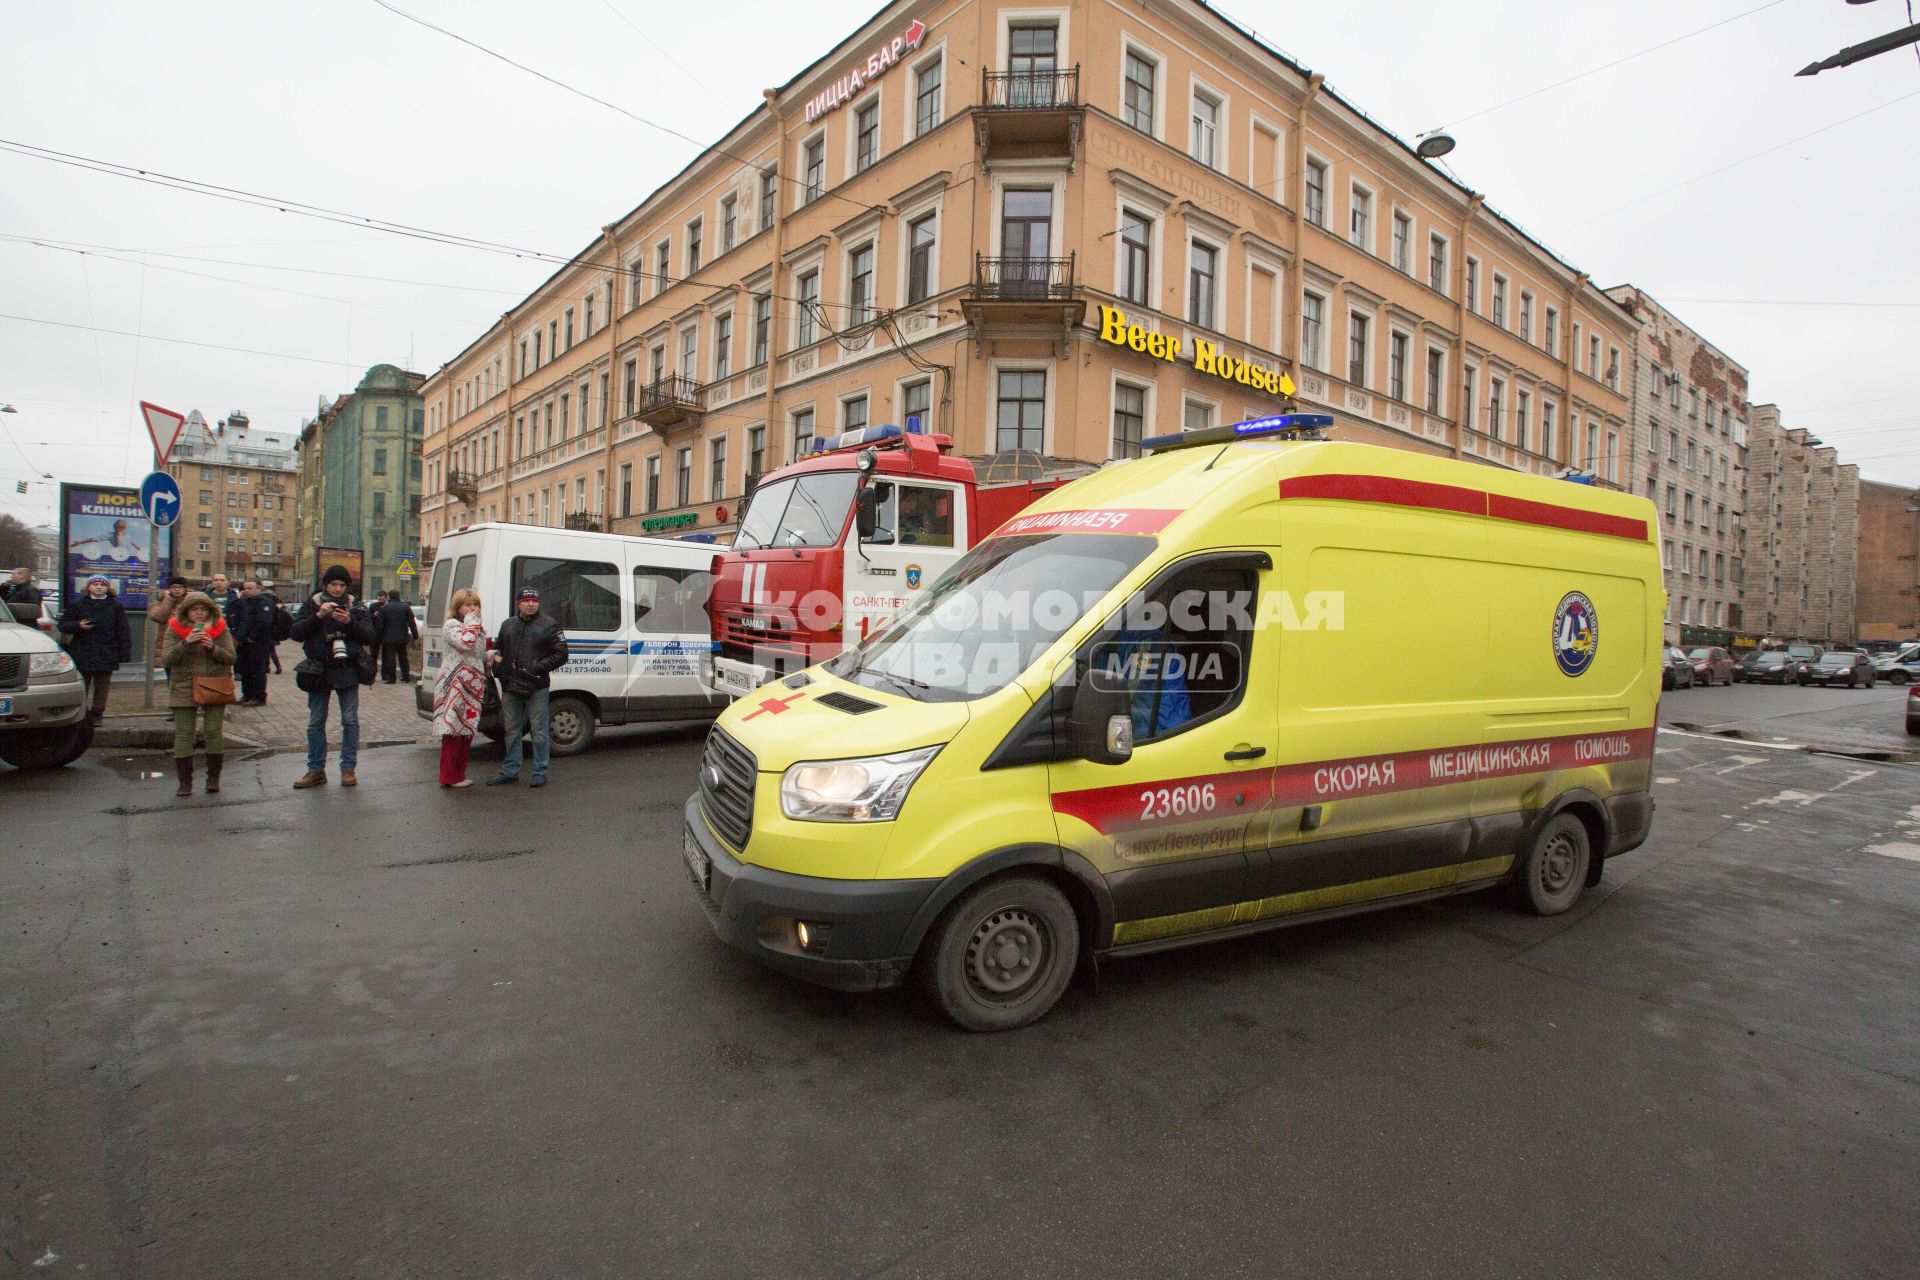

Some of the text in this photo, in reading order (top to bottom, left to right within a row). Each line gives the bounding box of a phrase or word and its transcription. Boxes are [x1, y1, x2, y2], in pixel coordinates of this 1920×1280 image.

[804, 36, 903, 123] ПИЦЦА-БАР
[1098, 304, 1280, 395] Beer House
[96, 494, 138, 506] ЛОР
[641, 512, 699, 532] супермаркет
[741, 617, 765, 629] КАМАЗ
[1314, 734, 1631, 795] СКОРАЯ МЕДИЦИНСКАЯ ПОМОЩЬ
[1139, 781, 1217, 821] 23606
[1113, 826, 1243, 860] Санкт-Петербург
